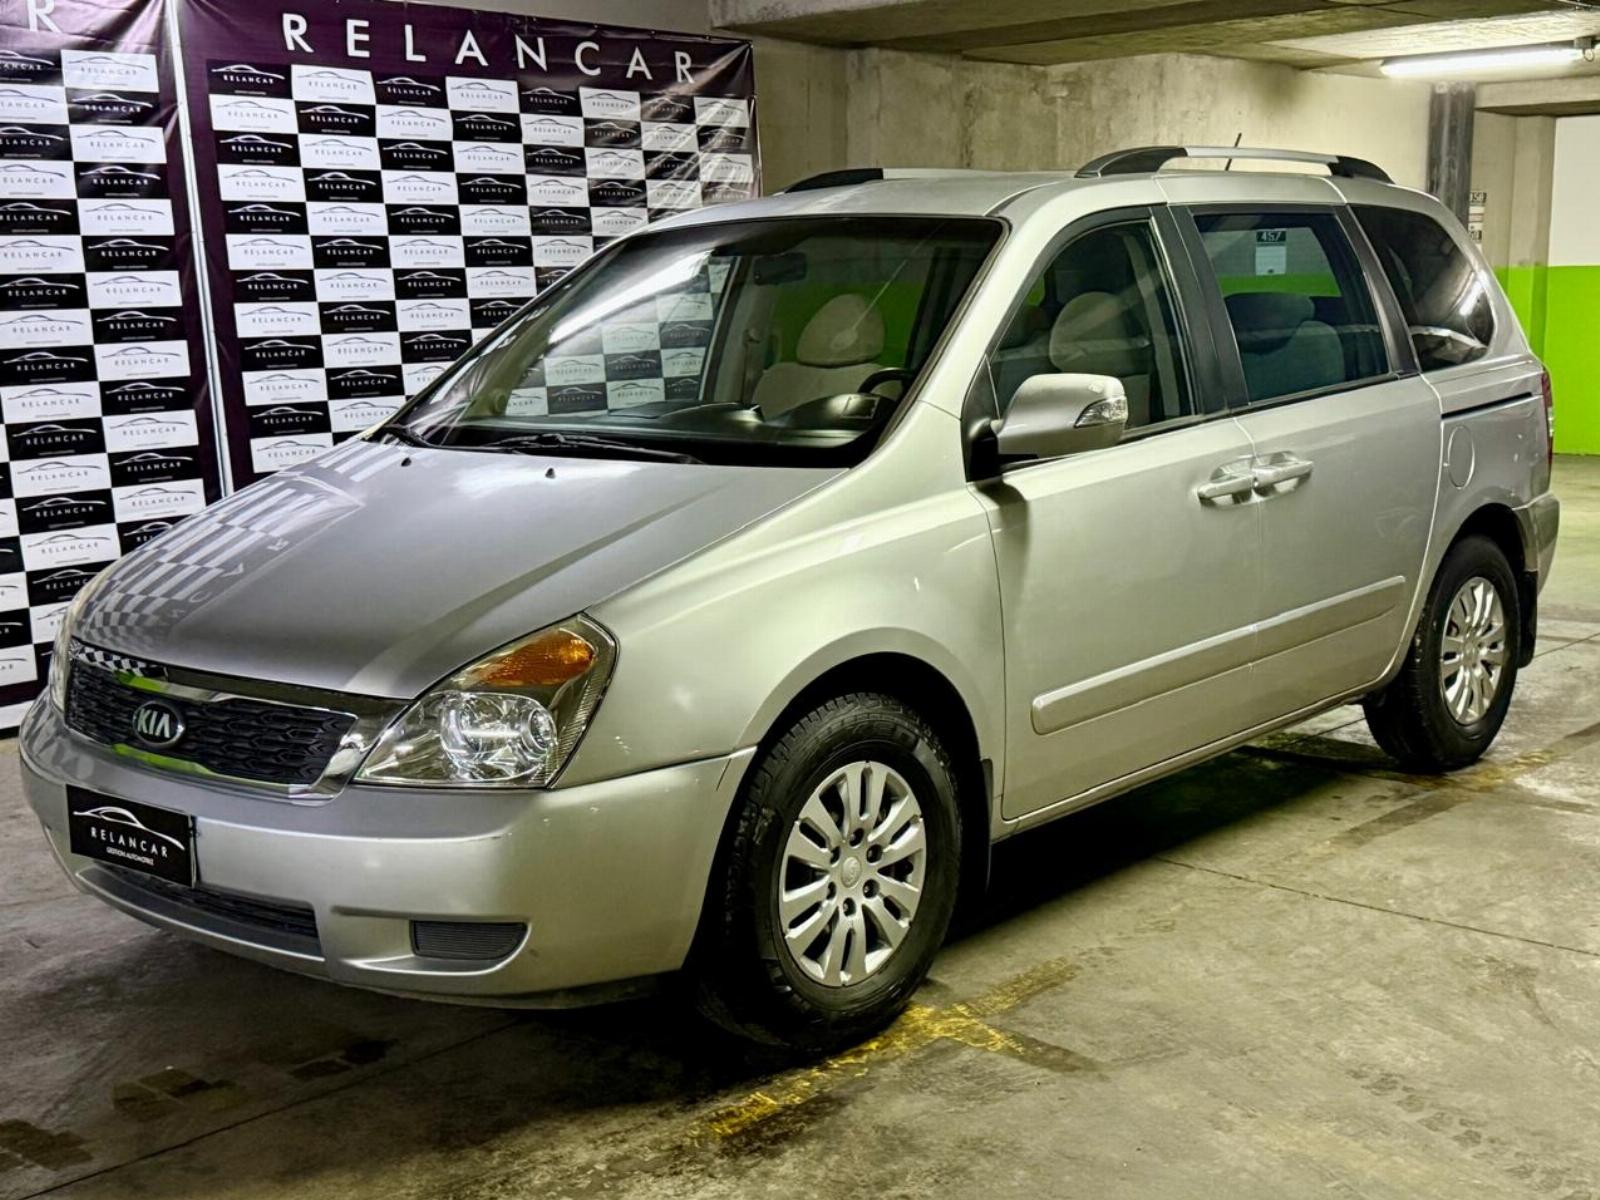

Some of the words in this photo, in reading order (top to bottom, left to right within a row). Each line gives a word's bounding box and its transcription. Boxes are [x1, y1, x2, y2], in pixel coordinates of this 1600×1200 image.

[282, 13, 695, 83] RELANCAR
[137, 708, 171, 738] KIA
[91, 826, 168, 858] RELANCAR
